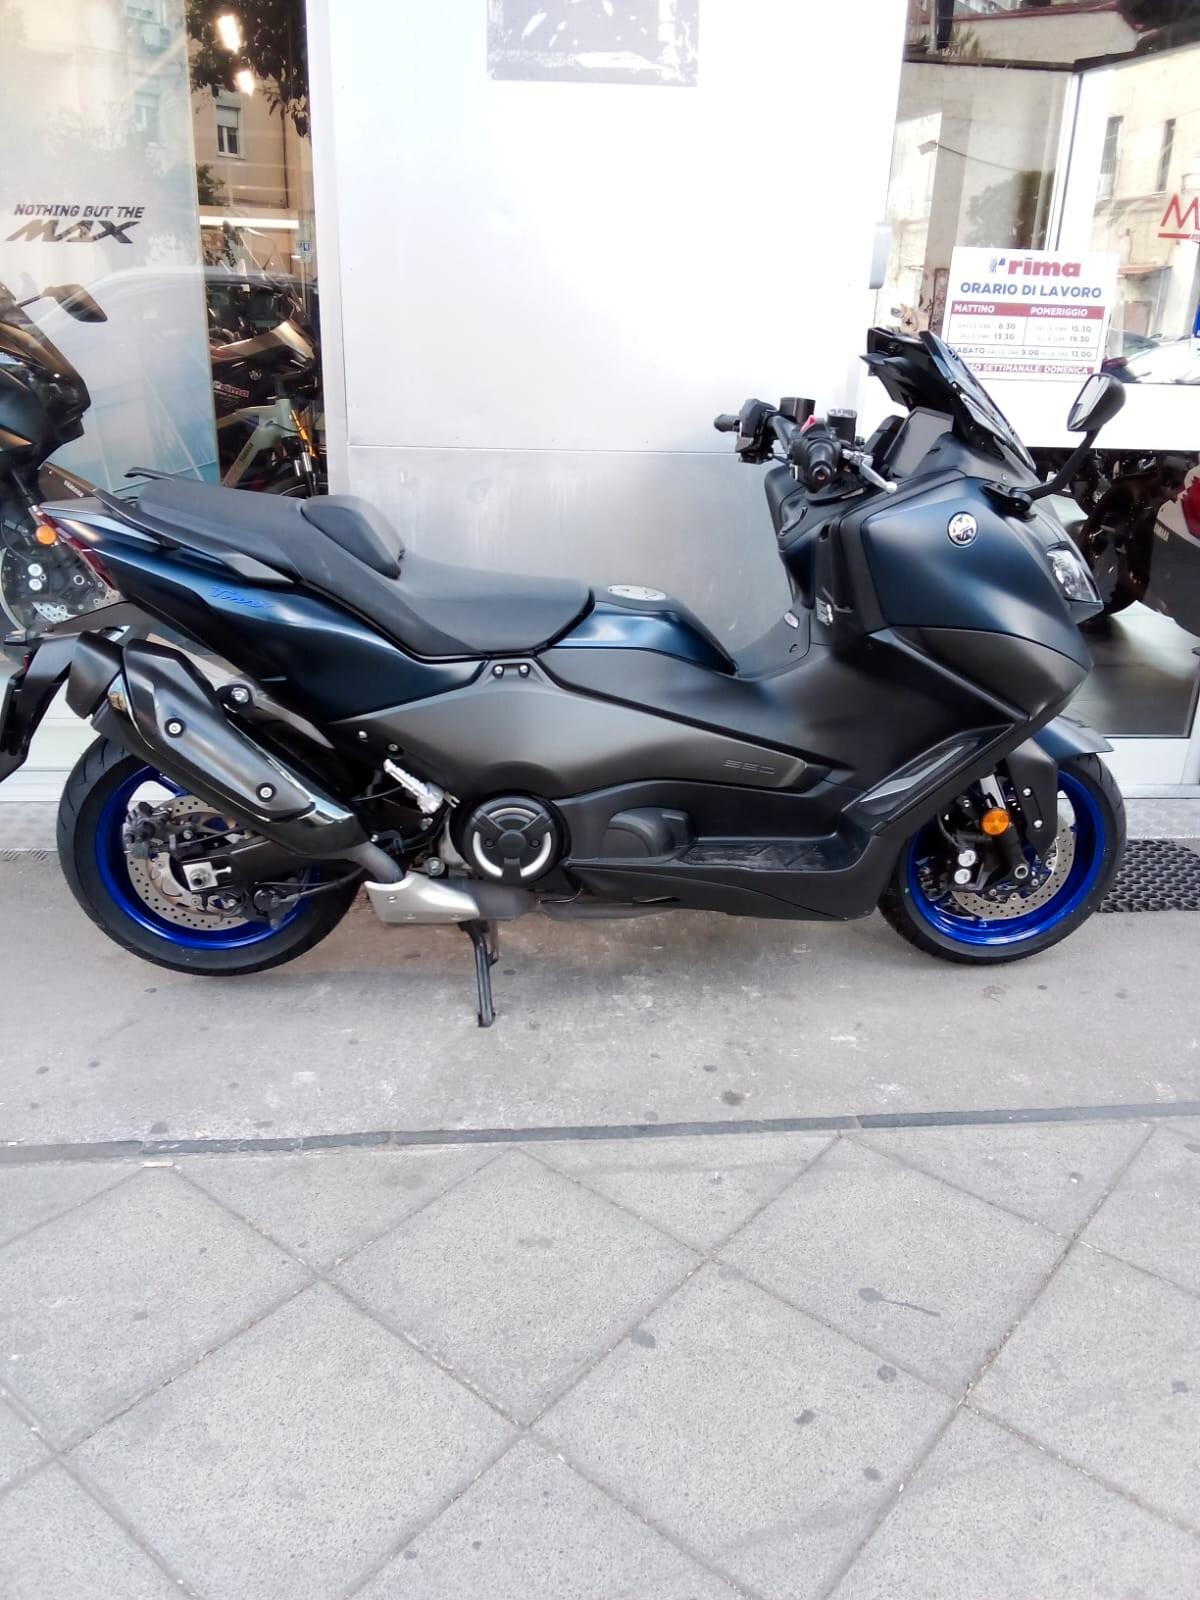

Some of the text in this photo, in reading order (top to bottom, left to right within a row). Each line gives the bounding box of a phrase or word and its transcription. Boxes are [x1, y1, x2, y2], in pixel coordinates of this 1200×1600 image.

[14, 204, 145, 218] NOTHING BUT THE
[5, 219, 140, 244] MAX
[960, 282, 1102, 298] ORARIO DI LAVORO
[954, 303, 995, 313] MATTINO
[1030, 307, 1088, 317] POMERIGGIO
